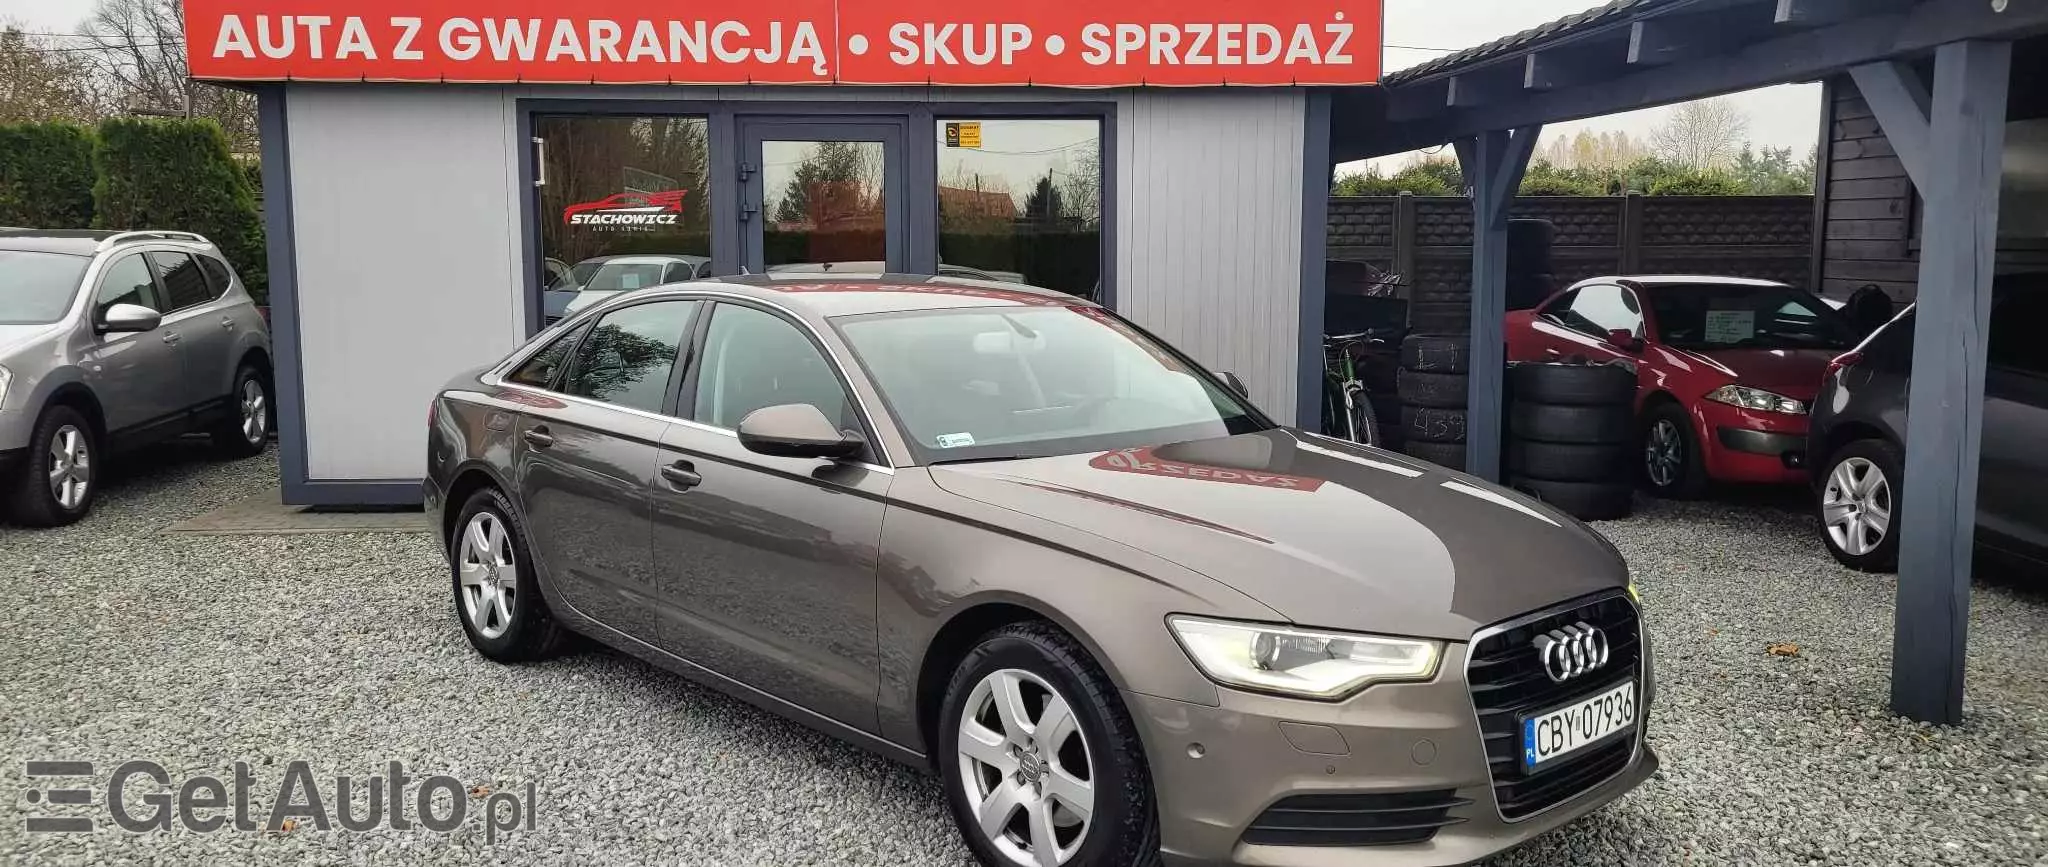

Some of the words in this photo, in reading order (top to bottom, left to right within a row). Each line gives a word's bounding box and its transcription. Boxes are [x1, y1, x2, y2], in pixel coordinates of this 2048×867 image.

[211, 14, 378, 60] AUTA
[390, 17, 424, 60] Z
[438, 17, 828, 76] GWARANCJĄ
[888, 22, 1033, 65] SKUP
[1080, 11, 1354, 65] SPRZEDAŻ
[570, 214, 678, 225] STACHOWICZ
[1537, 709, 1575, 756] CBY
[1582, 685, 1632, 740] 07936
[1526, 748, 1535, 759] PL
